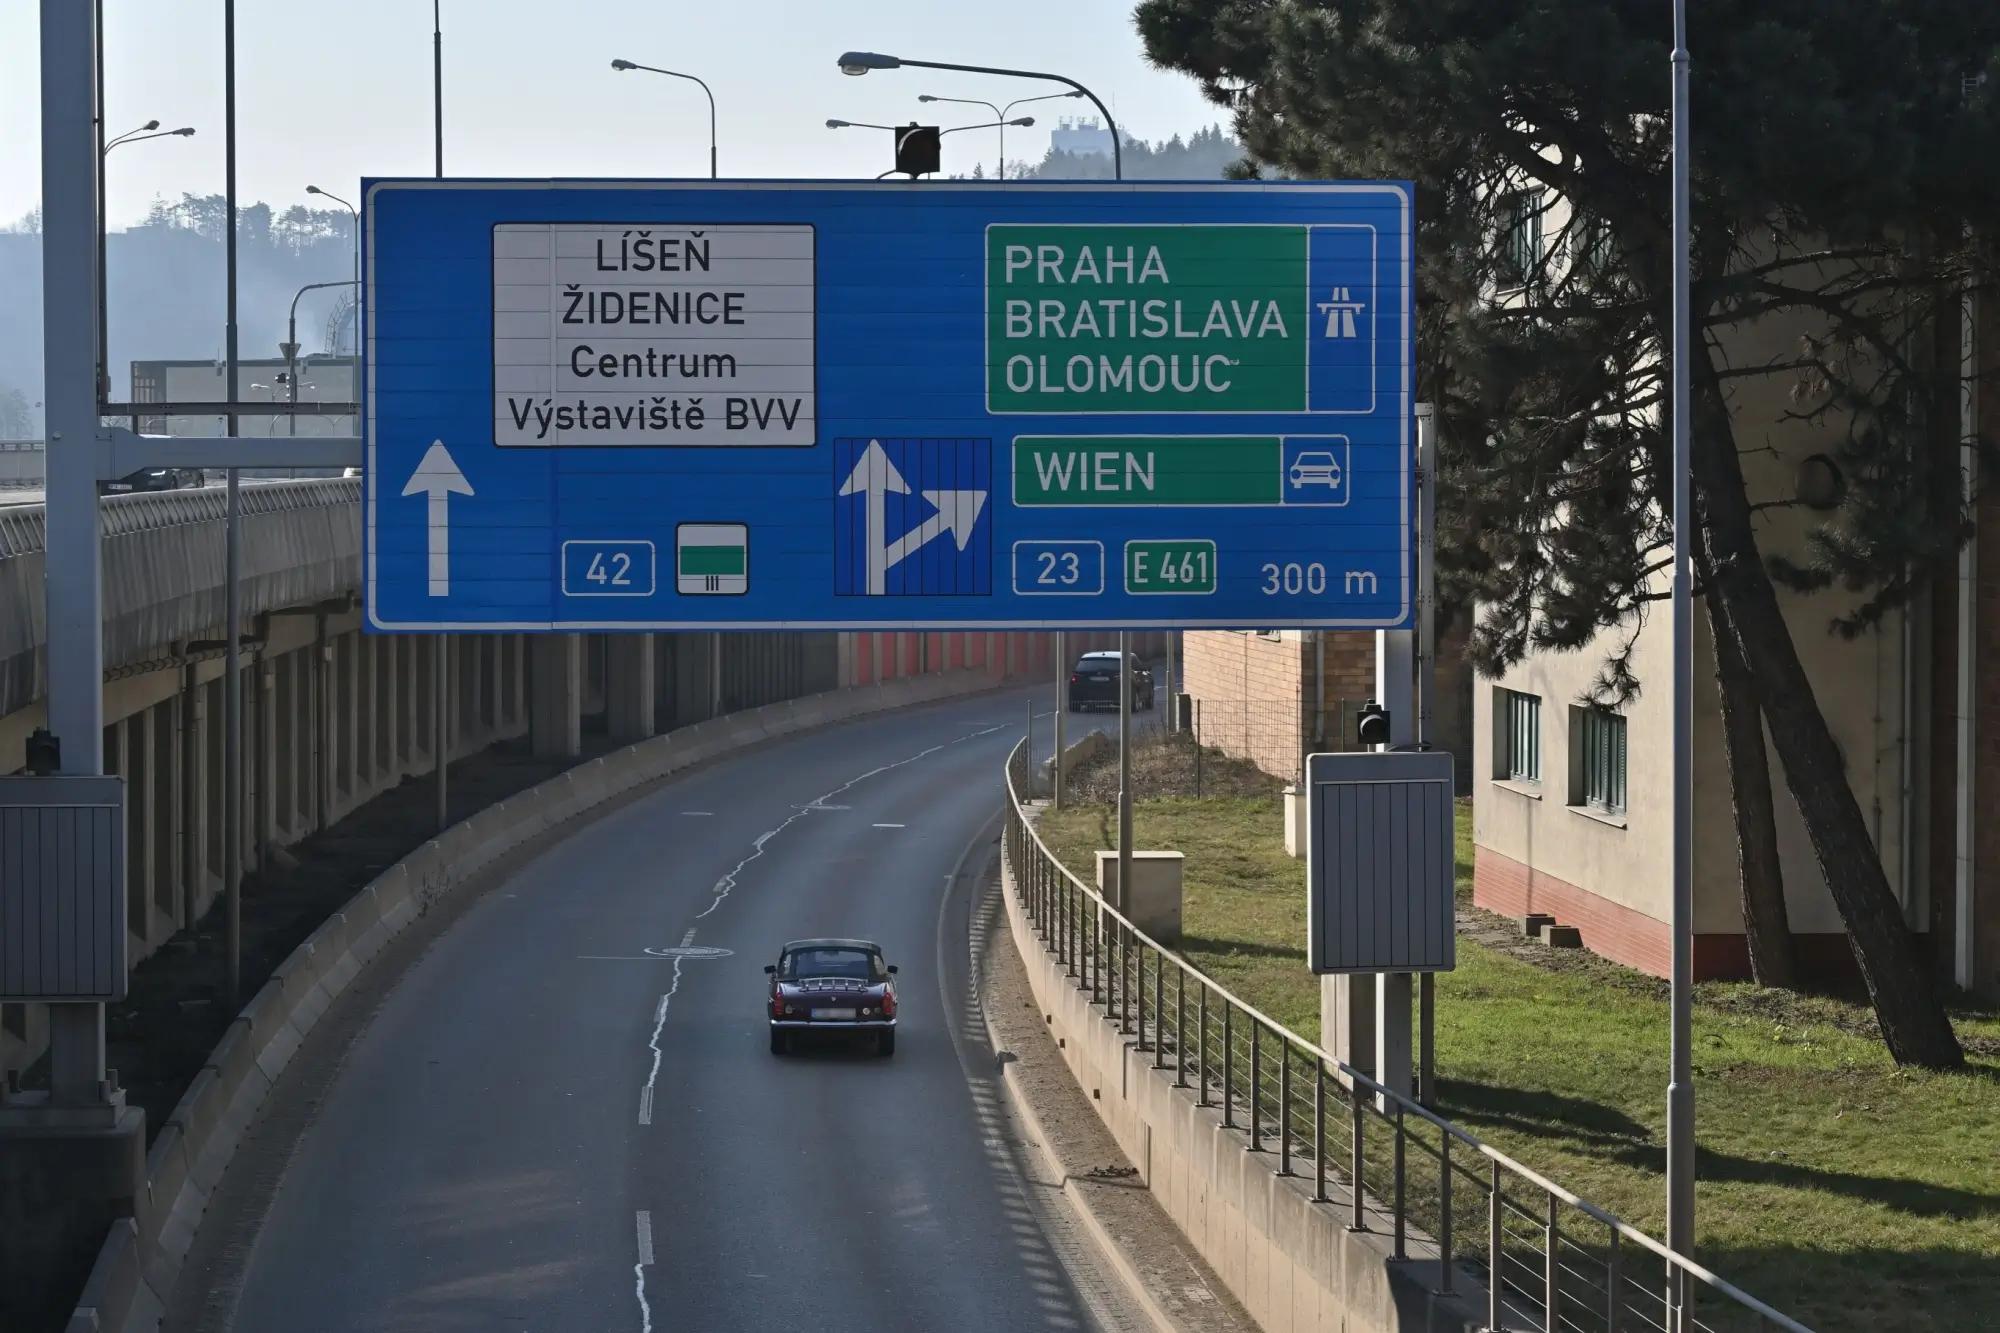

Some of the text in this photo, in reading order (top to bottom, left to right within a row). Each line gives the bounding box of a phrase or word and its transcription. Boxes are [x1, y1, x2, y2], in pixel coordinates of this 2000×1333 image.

[596, 230, 710, 272] LÍŠEŇ
[1005, 245, 1169, 284] PRAHA
[562, 283, 745, 325] ŽIDENICE
[1006, 299, 1289, 338] BRATISLAVA
[571, 345, 736, 378] Centrum
[1006, 354, 1233, 393] OLOMOUC
[508, 396, 802, 440] Výstaviště BVV
[1034, 451, 1155, 491] WIEN
[586, 552, 631, 585] 42
[1037, 552, 1079, 585] 23
[1134, 551, 1207, 584] E 461
[1261, 562, 1377, 595] 300 m
